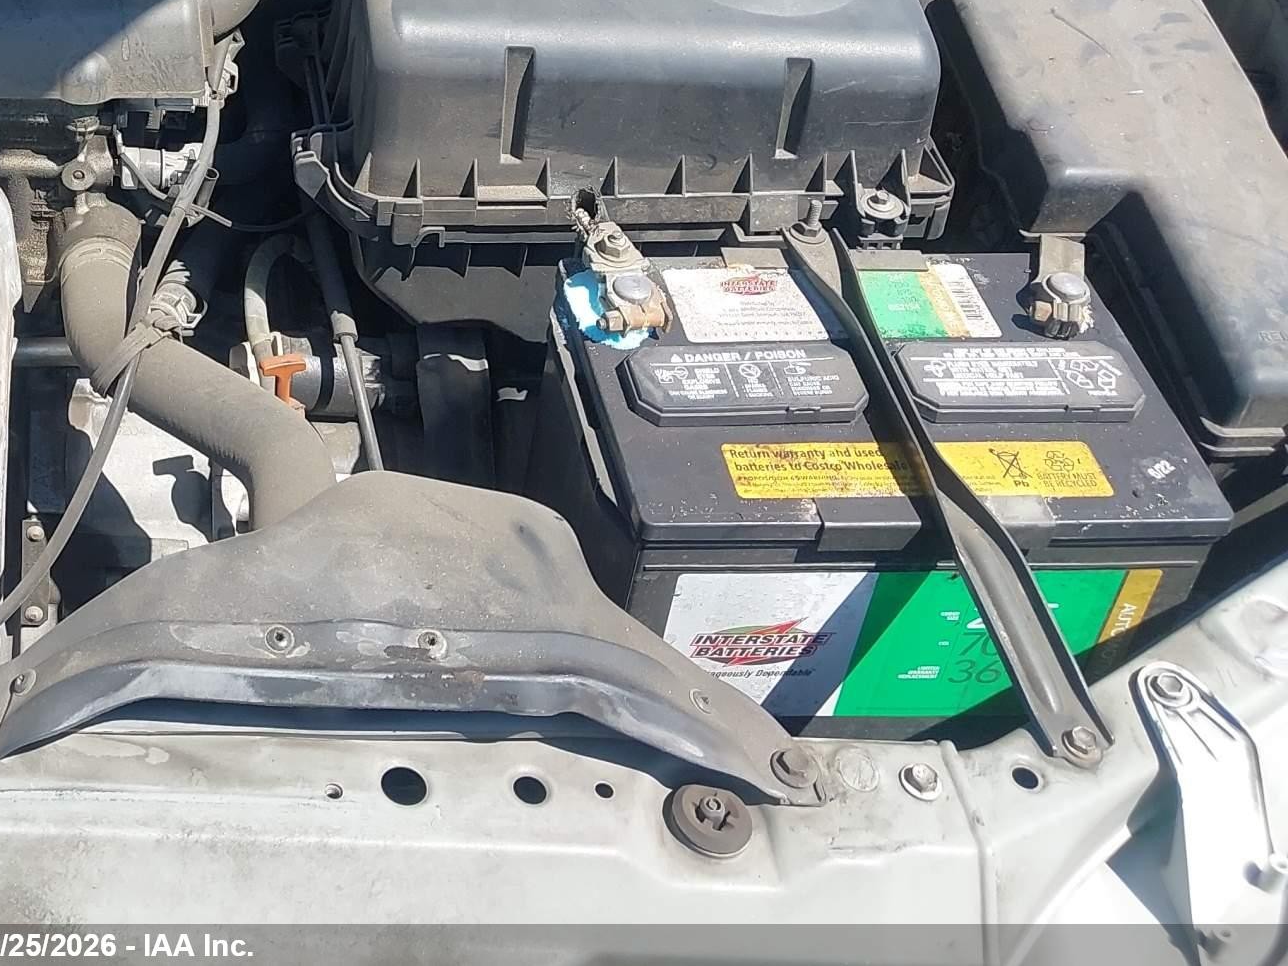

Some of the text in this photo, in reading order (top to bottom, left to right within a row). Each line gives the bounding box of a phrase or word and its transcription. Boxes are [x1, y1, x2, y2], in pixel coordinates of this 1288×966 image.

[683, 352, 742, 363] DANGER
[754, 349, 808, 361] POISON
[729, 448, 770, 459] Return
[772, 448, 826, 461] warranty
[854, 447, 884, 458] used
[734, 460, 907, 472] batteries to Costco Wholesale
[1037, 472, 1098, 480] BATTERY MUST
[1014, 480, 1030, 488] Pb
[1042, 479, 1099, 488] BE RECYCLED
[694, 634, 828, 645] INTERSTATE
[694, 646, 815, 657] BATTERIES
